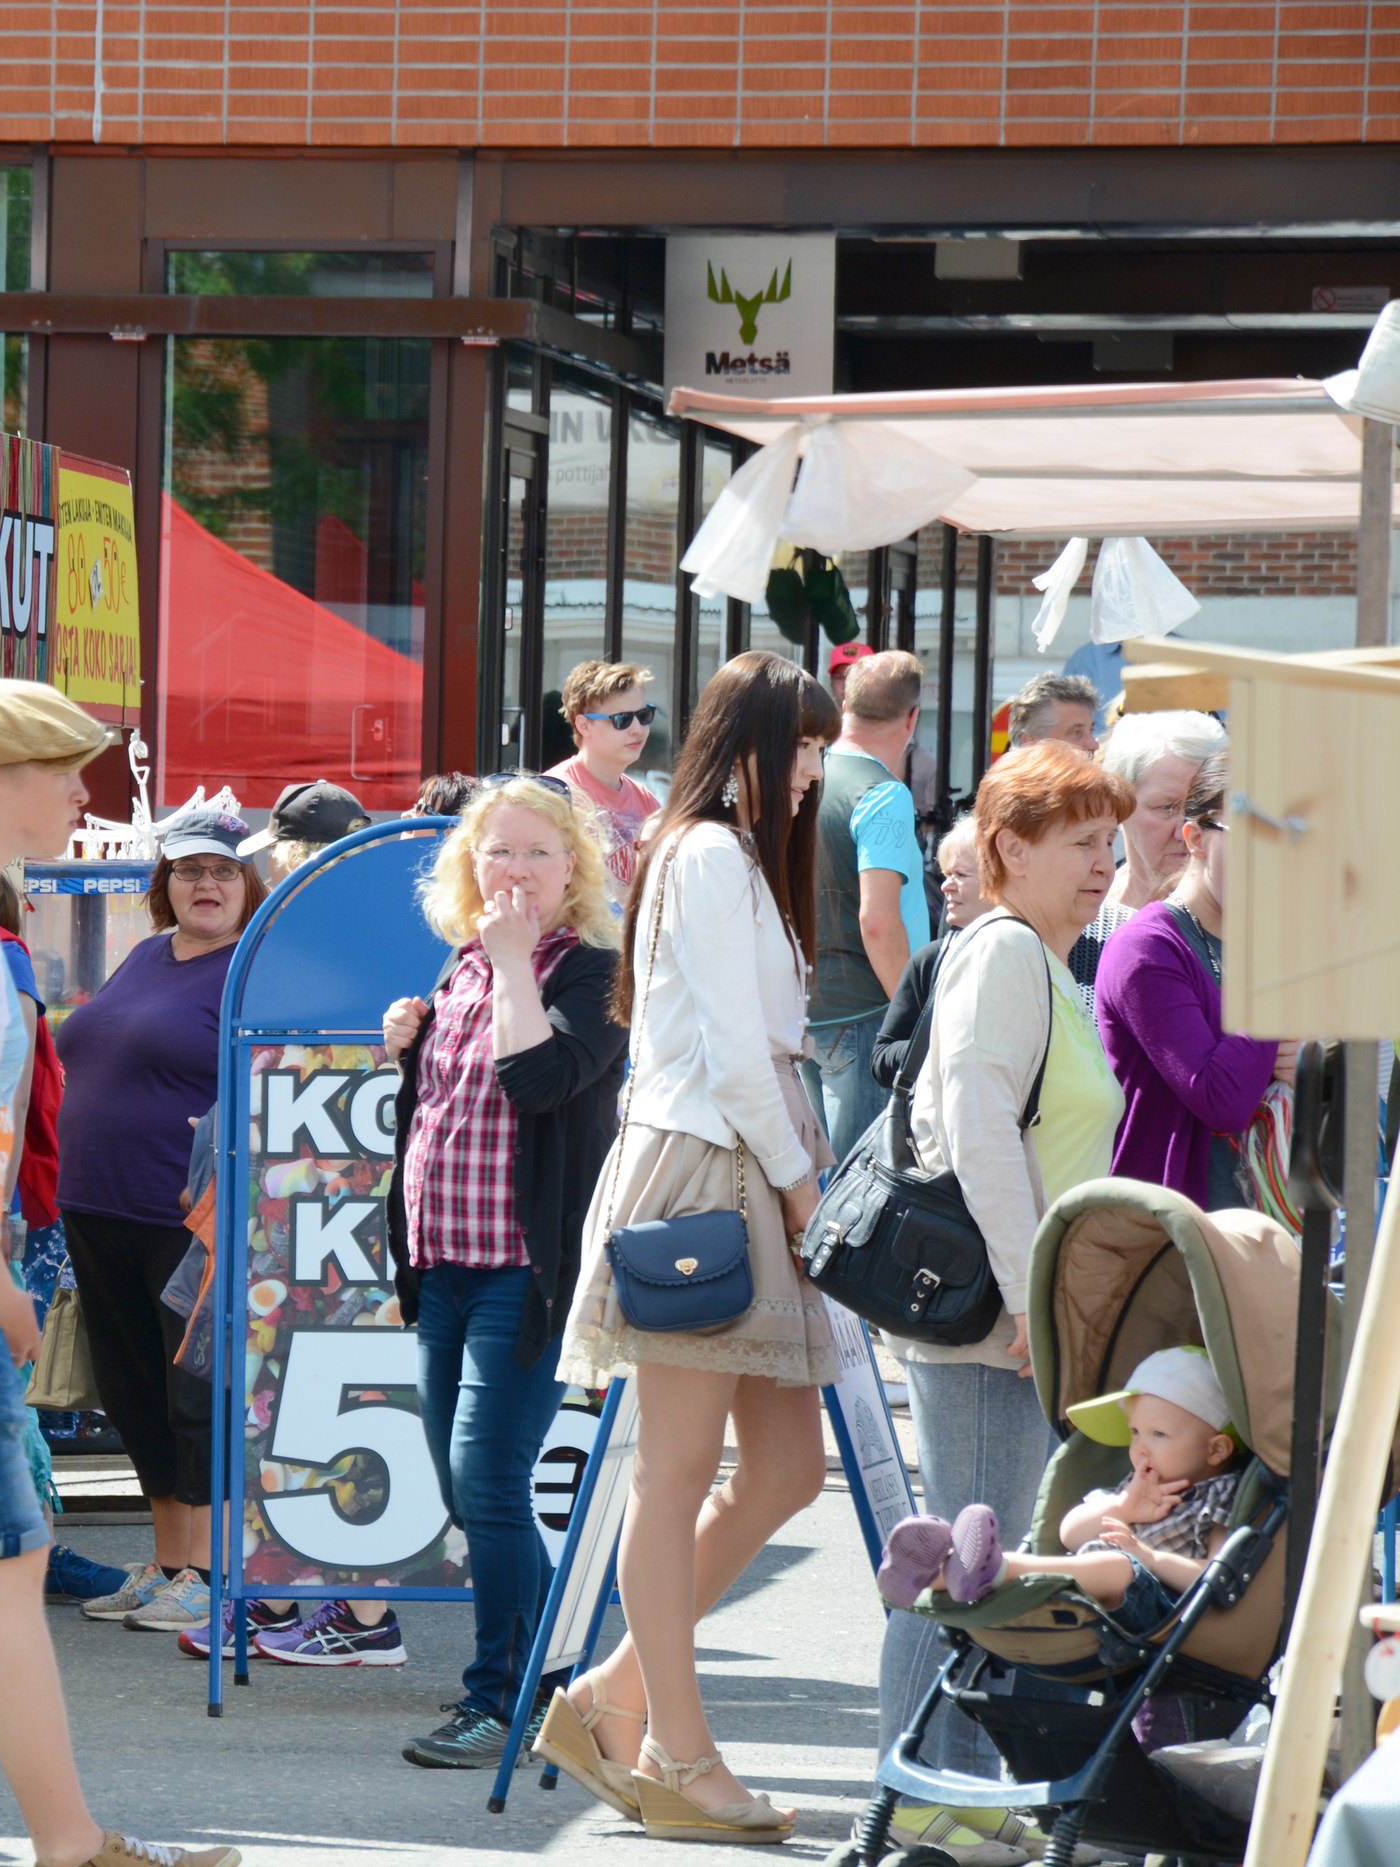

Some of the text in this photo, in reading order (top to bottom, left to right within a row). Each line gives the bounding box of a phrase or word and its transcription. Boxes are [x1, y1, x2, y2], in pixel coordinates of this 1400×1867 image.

[705, 351, 791, 376] Metsä
[67, 532, 87, 615] 80
[55, 622, 80, 678] OSTA
[84, 626, 107, 681] KOKO
[83, 878, 141, 893] PEPSI
[295, 1202, 397, 1281] K
